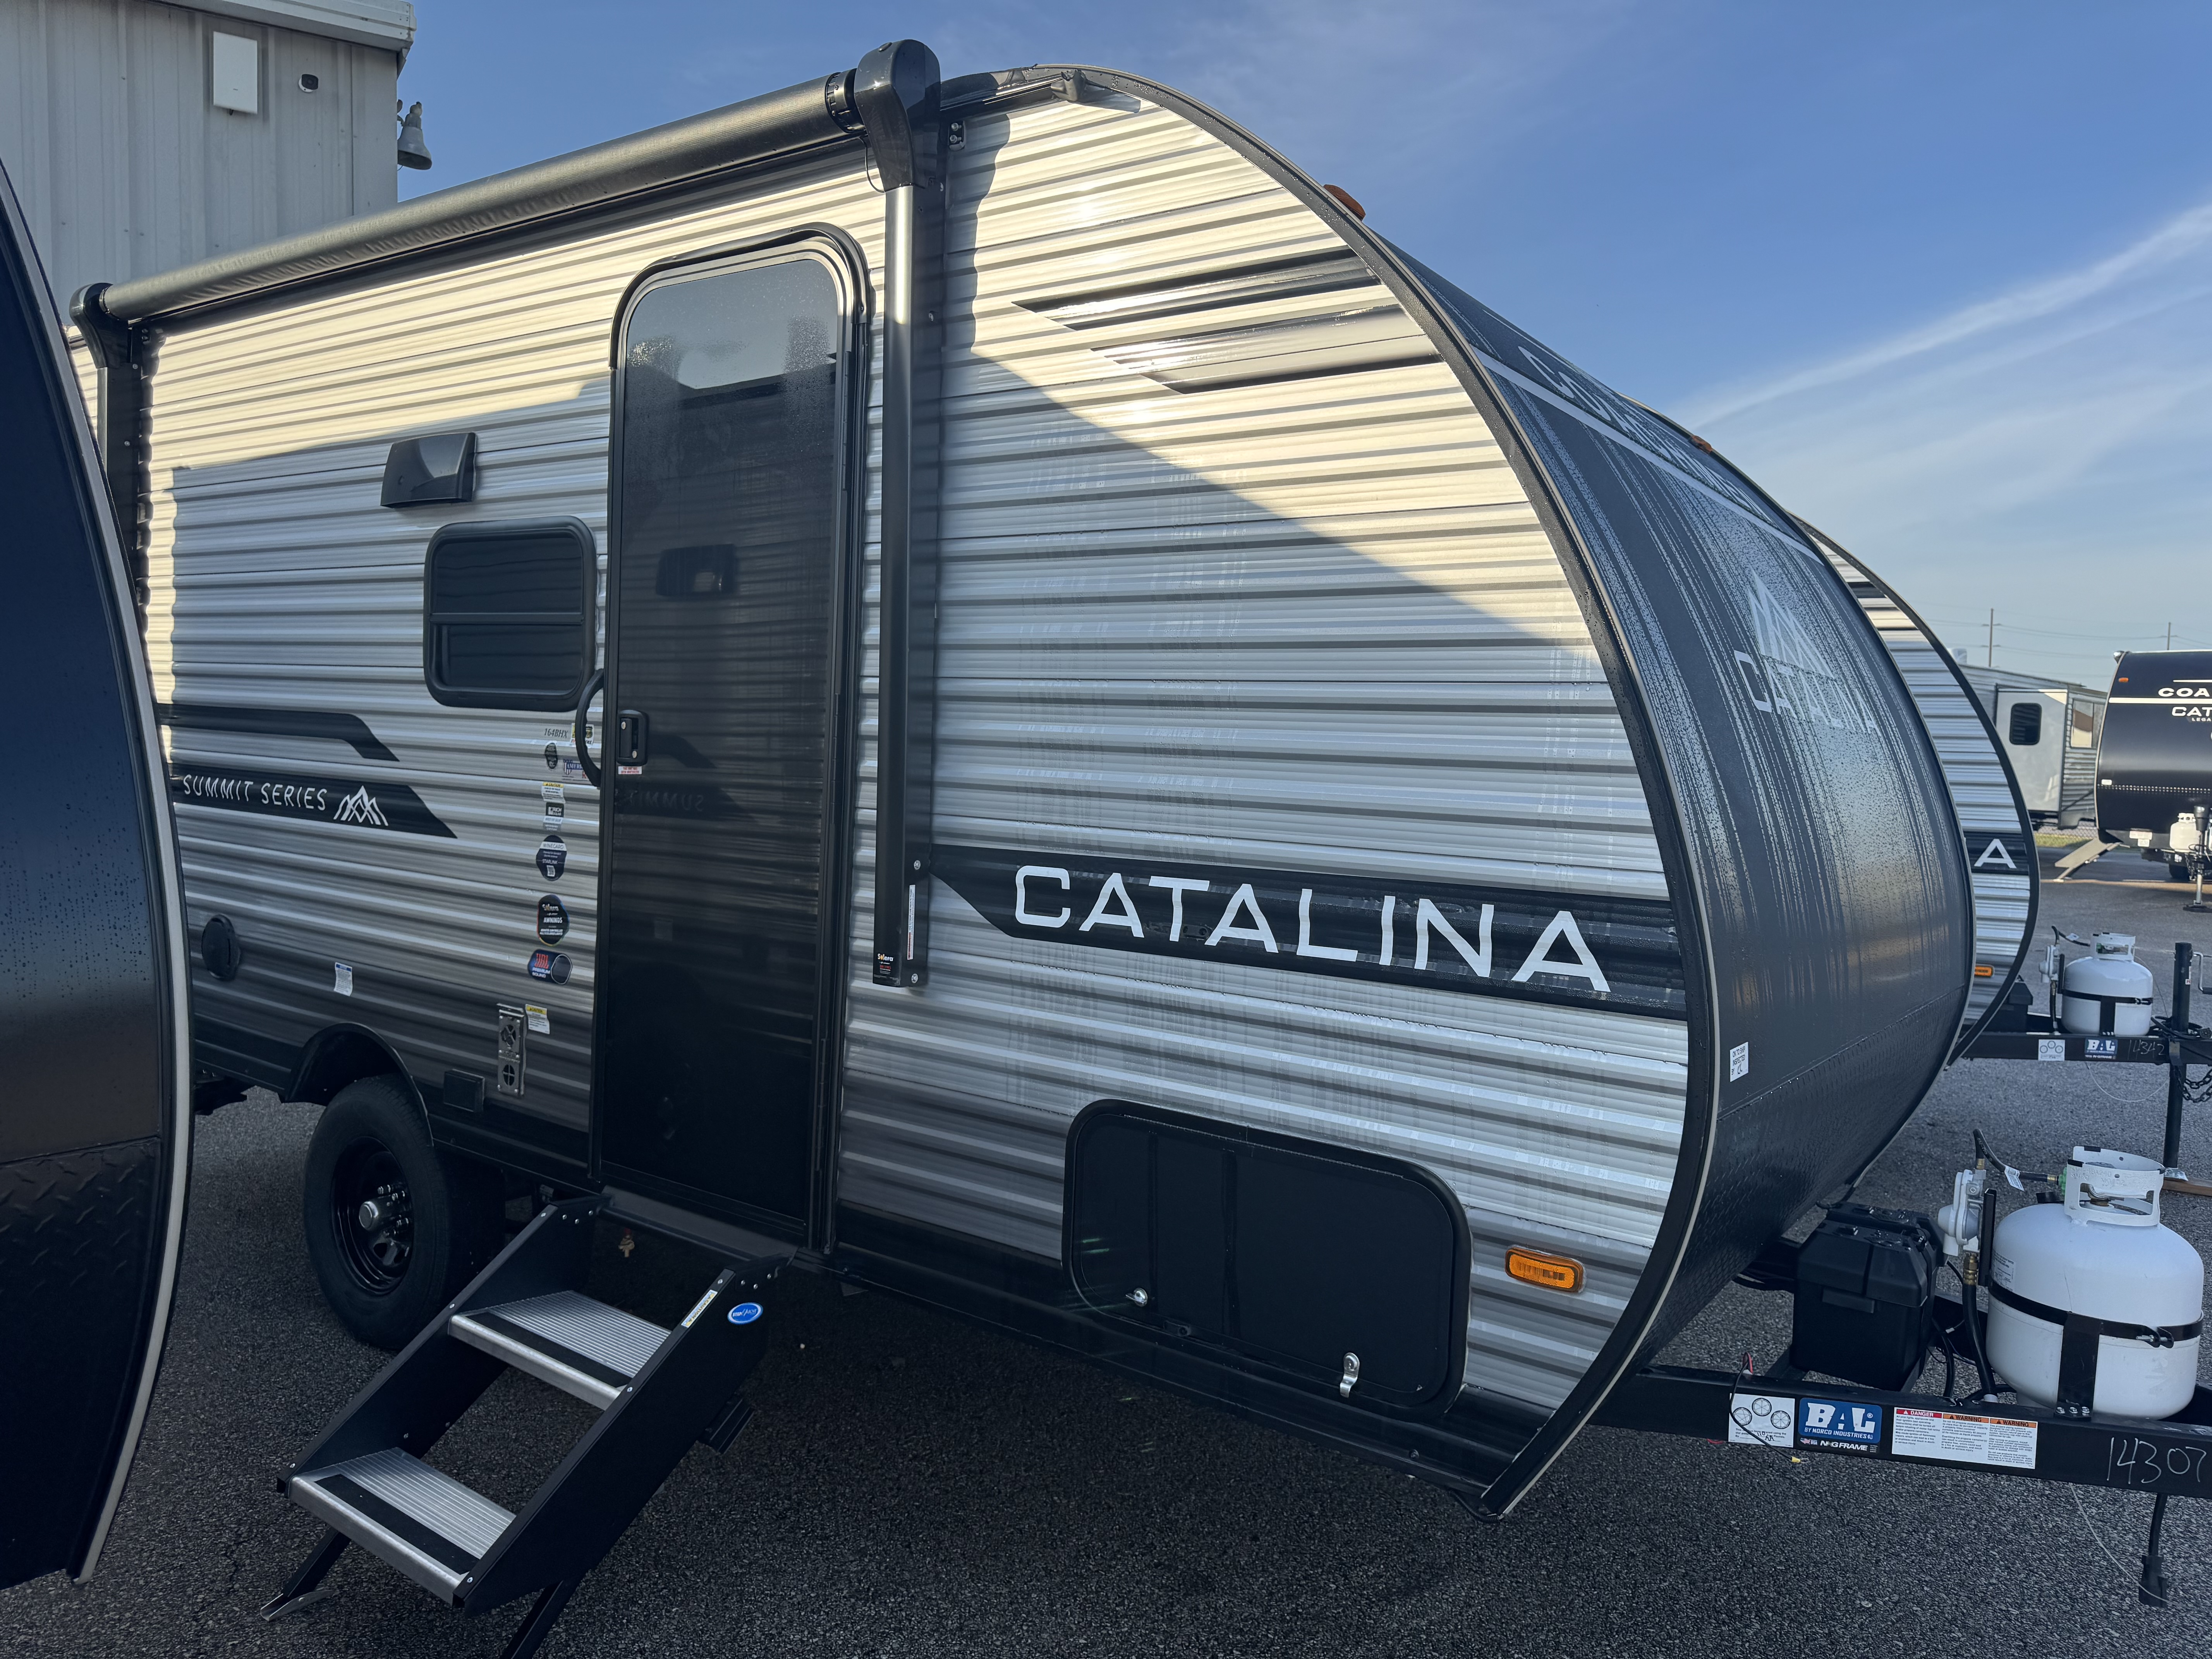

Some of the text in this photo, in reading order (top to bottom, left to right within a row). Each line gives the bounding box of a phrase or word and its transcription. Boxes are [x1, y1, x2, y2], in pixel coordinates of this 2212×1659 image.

[544, 728, 568, 738] 164BHX
[183, 775, 326, 811] SUMMIT SERIES
[1015, 865, 1610, 993] CATALINA
[878, 953, 893, 962] Solera
[2128, 1039, 2165, 1060] 14342
[1833, 1430, 1867, 1439] INDUSTRIES
[2107, 1437, 2207, 1484] 14307
